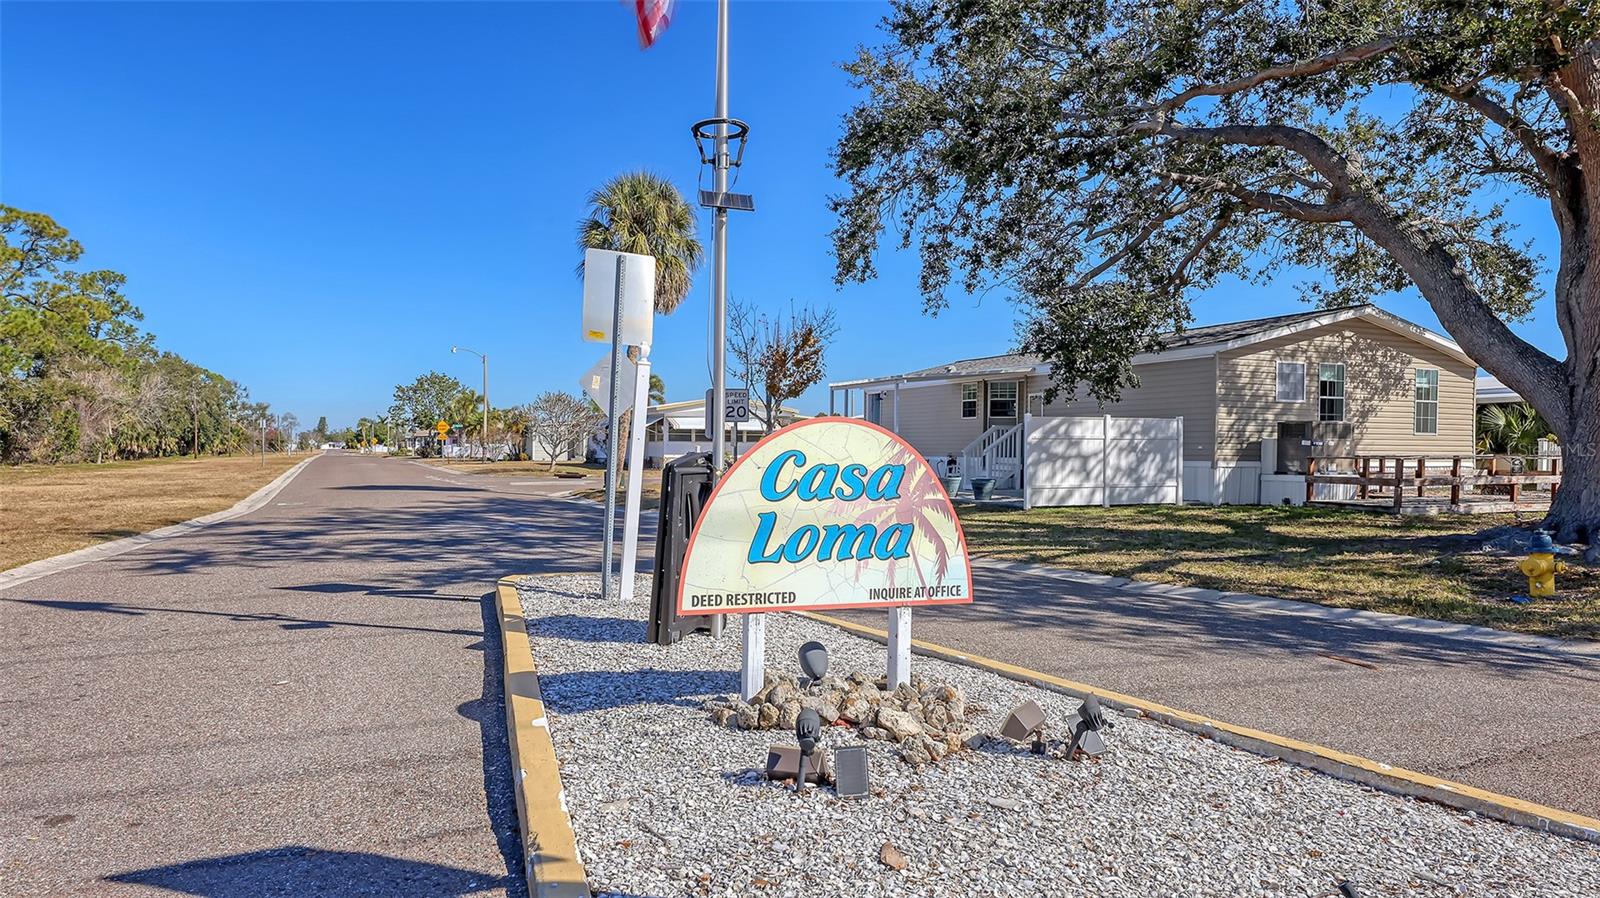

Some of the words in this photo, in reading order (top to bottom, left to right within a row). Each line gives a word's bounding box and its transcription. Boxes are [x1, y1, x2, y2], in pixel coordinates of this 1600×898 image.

[725, 405, 747, 418] 20
[760, 449, 906, 502] Casa
[747, 511, 915, 564] Loma
[691, 594, 723, 608] DEED
[726, 591, 797, 606] RESTRICTED
[869, 587, 912, 601] INQUIRE
[914, 586, 927, 598] AT
[928, 584, 962, 598] OFFICE
